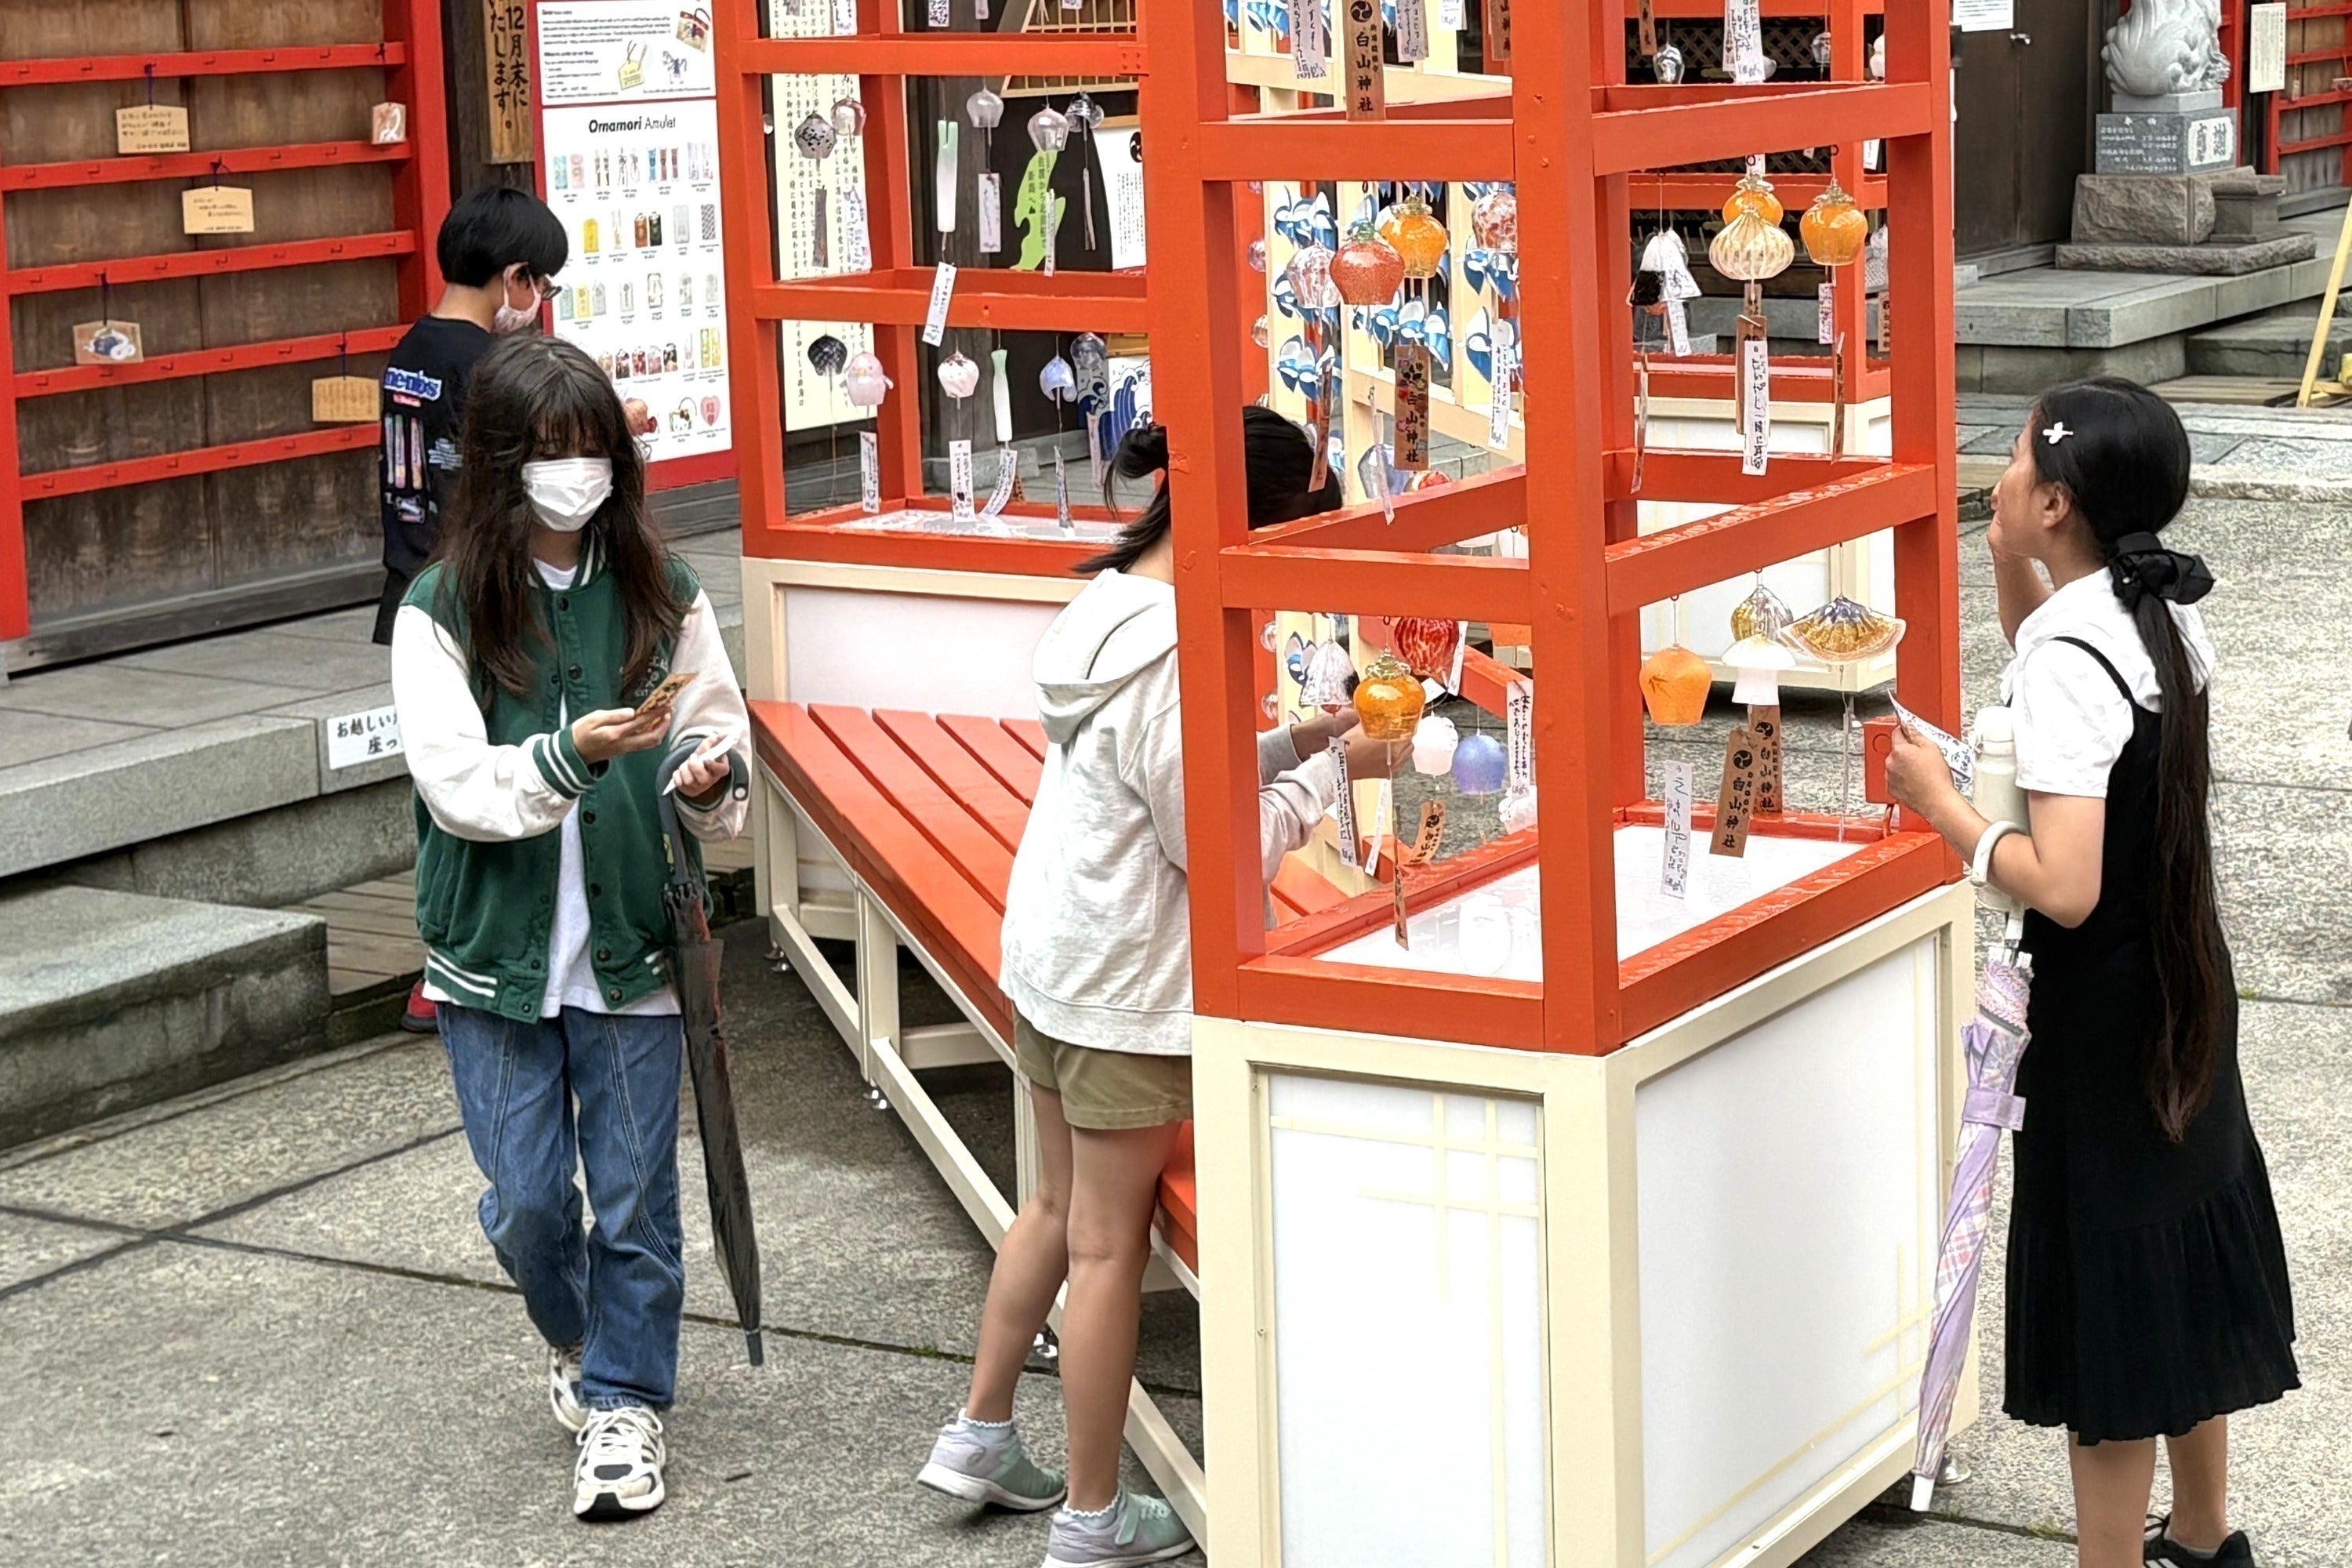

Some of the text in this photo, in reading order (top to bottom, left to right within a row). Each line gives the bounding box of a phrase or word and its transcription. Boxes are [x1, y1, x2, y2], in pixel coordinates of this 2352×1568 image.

[505, 5, 528, 109] 12月末に
[1356, 31, 1374, 111] 白山神社
